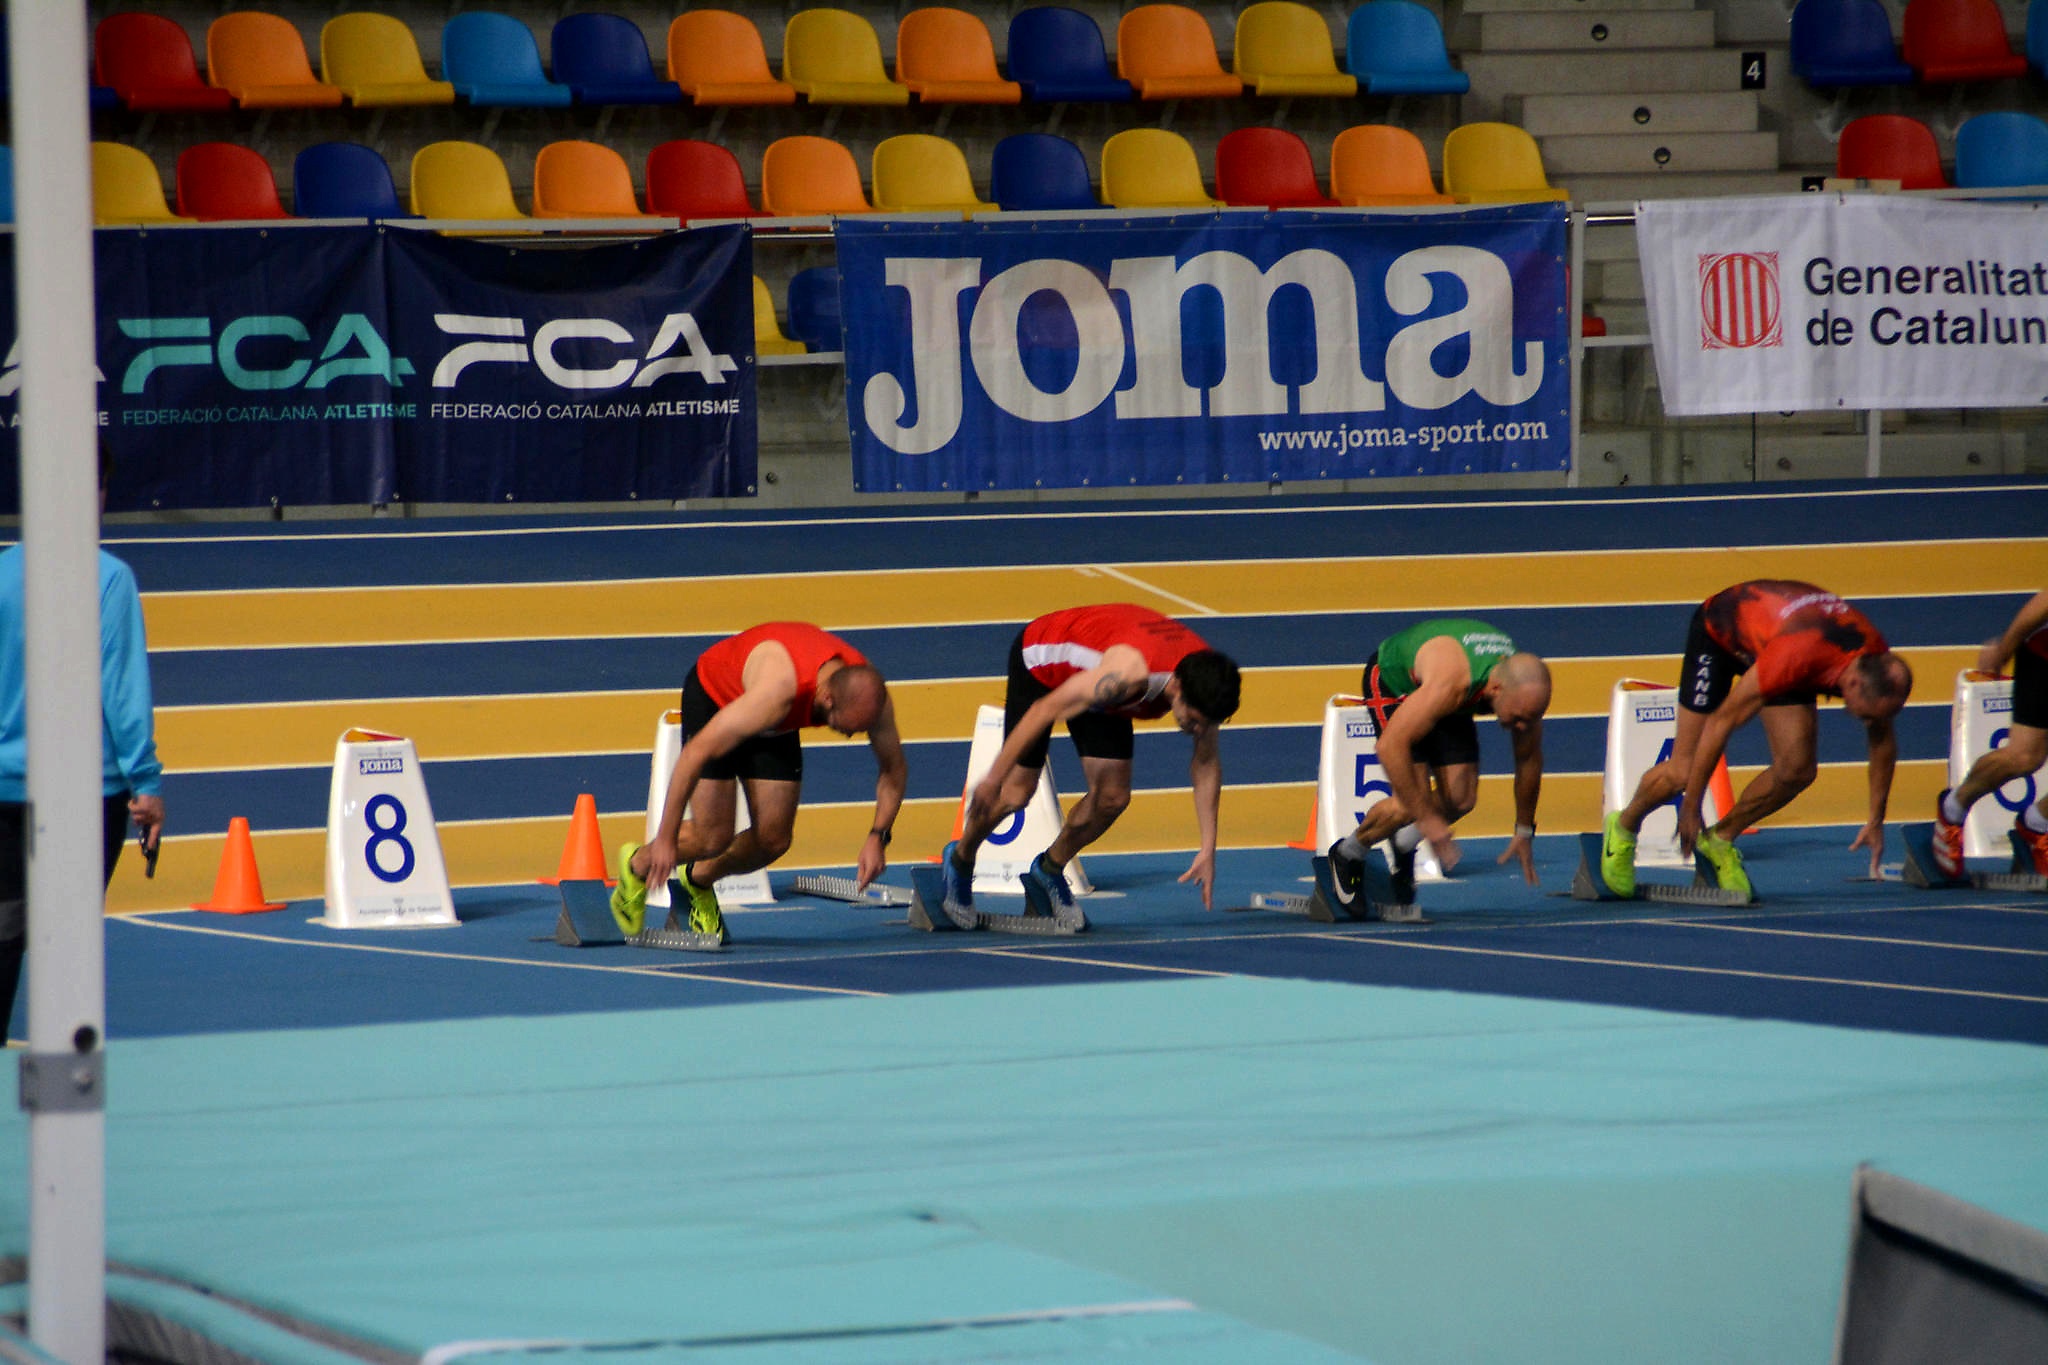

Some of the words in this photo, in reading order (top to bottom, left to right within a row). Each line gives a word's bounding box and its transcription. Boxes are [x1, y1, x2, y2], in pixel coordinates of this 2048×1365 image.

[1746, 60, 1762, 81] 4
[1804, 257, 2048, 297] Generalitat
[1806, 309, 1853, 347] de
[118, 314, 416, 394] FCA
[431, 313, 739, 388] FCA
[122, 404, 222, 425] FEDERACIÓ
[226, 406, 318, 422] CATALANA
[324, 403, 417, 419] ATLETISME
[430, 401, 542, 420] FEDERACIÓ
[546, 403, 642, 419] CATALANA
[646, 399, 740, 417] ATLETISME
[1259, 418, 1549, 456] www.joma-sport.com
[364, 794, 415, 883] 8
